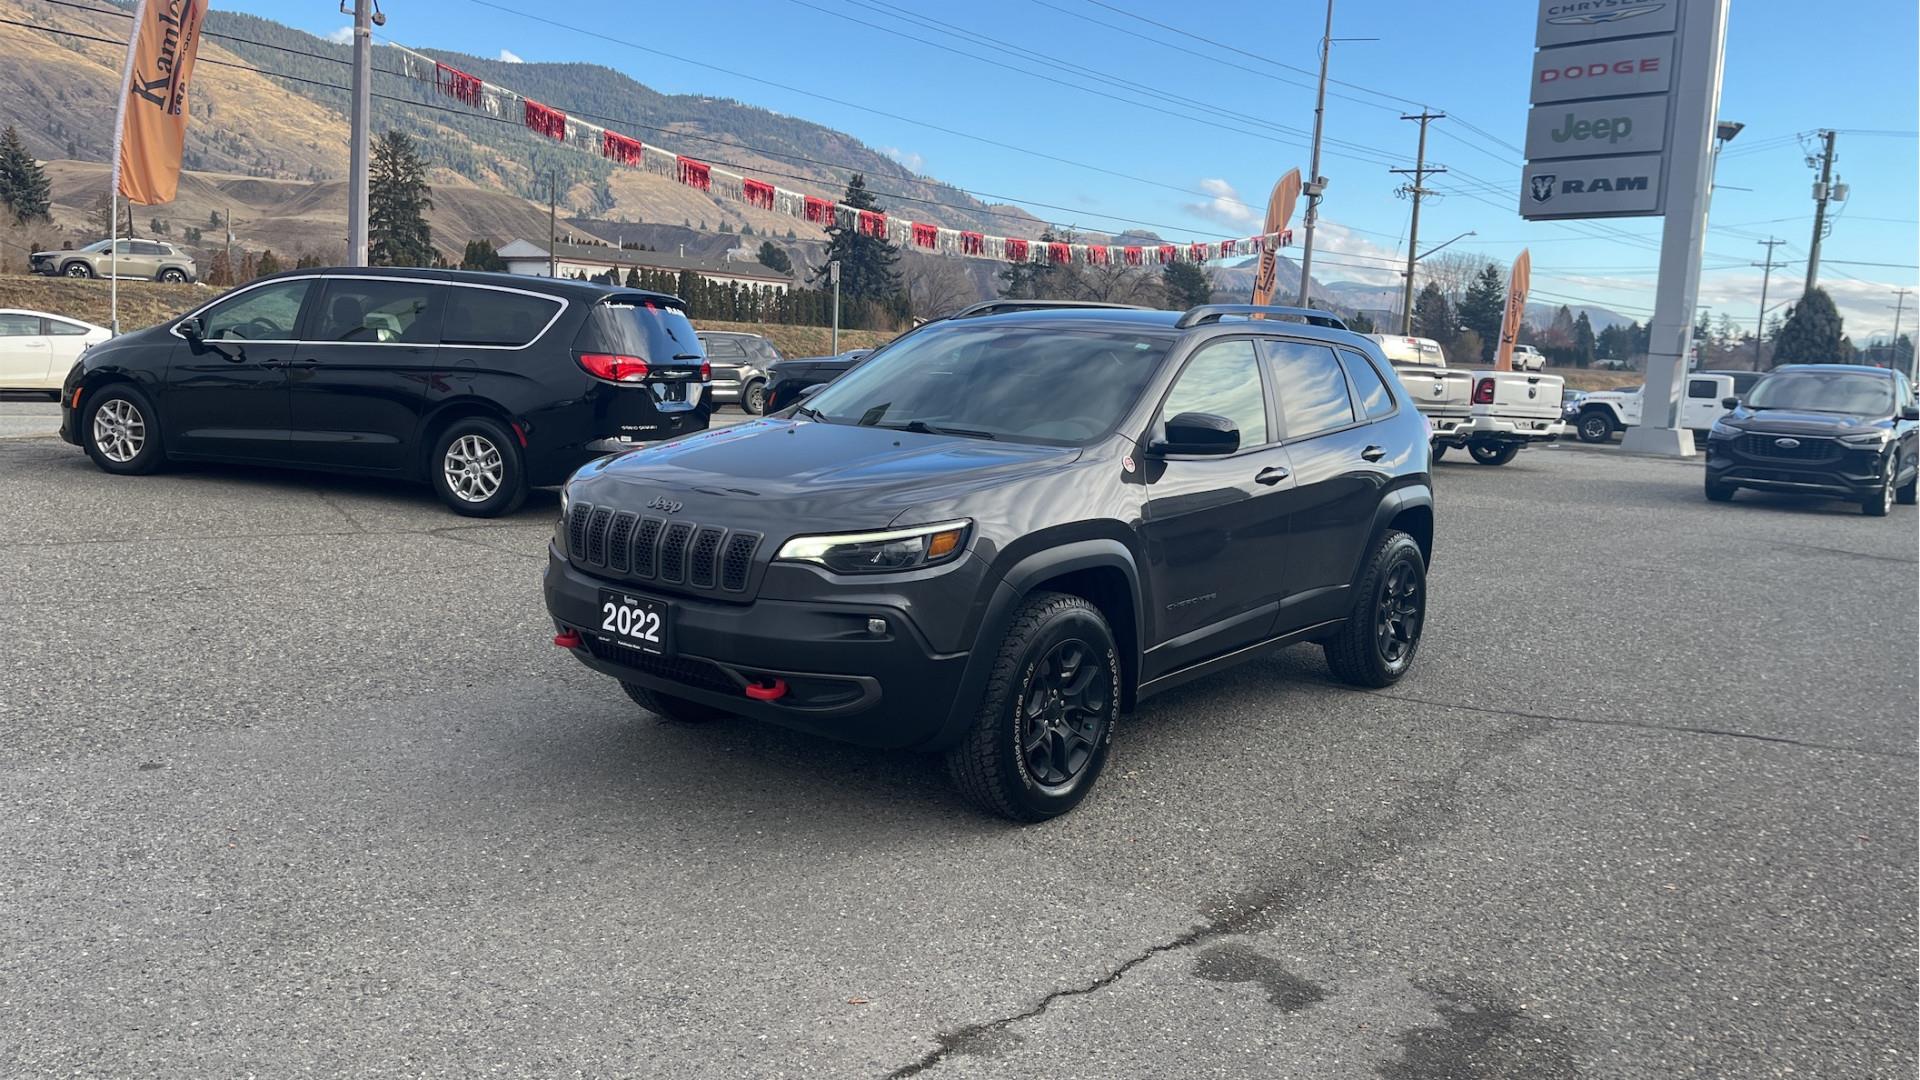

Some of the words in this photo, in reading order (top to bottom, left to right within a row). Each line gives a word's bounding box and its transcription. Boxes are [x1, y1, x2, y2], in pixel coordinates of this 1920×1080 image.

[132, 0, 180, 110] Kamlo
[1540, 57, 1660, 83] DODGE
[1551, 112, 1632, 144] Jeep
[1561, 176, 1648, 194] RAM
[647, 495, 683, 515] Jeep
[602, 602, 660, 643] 2022
